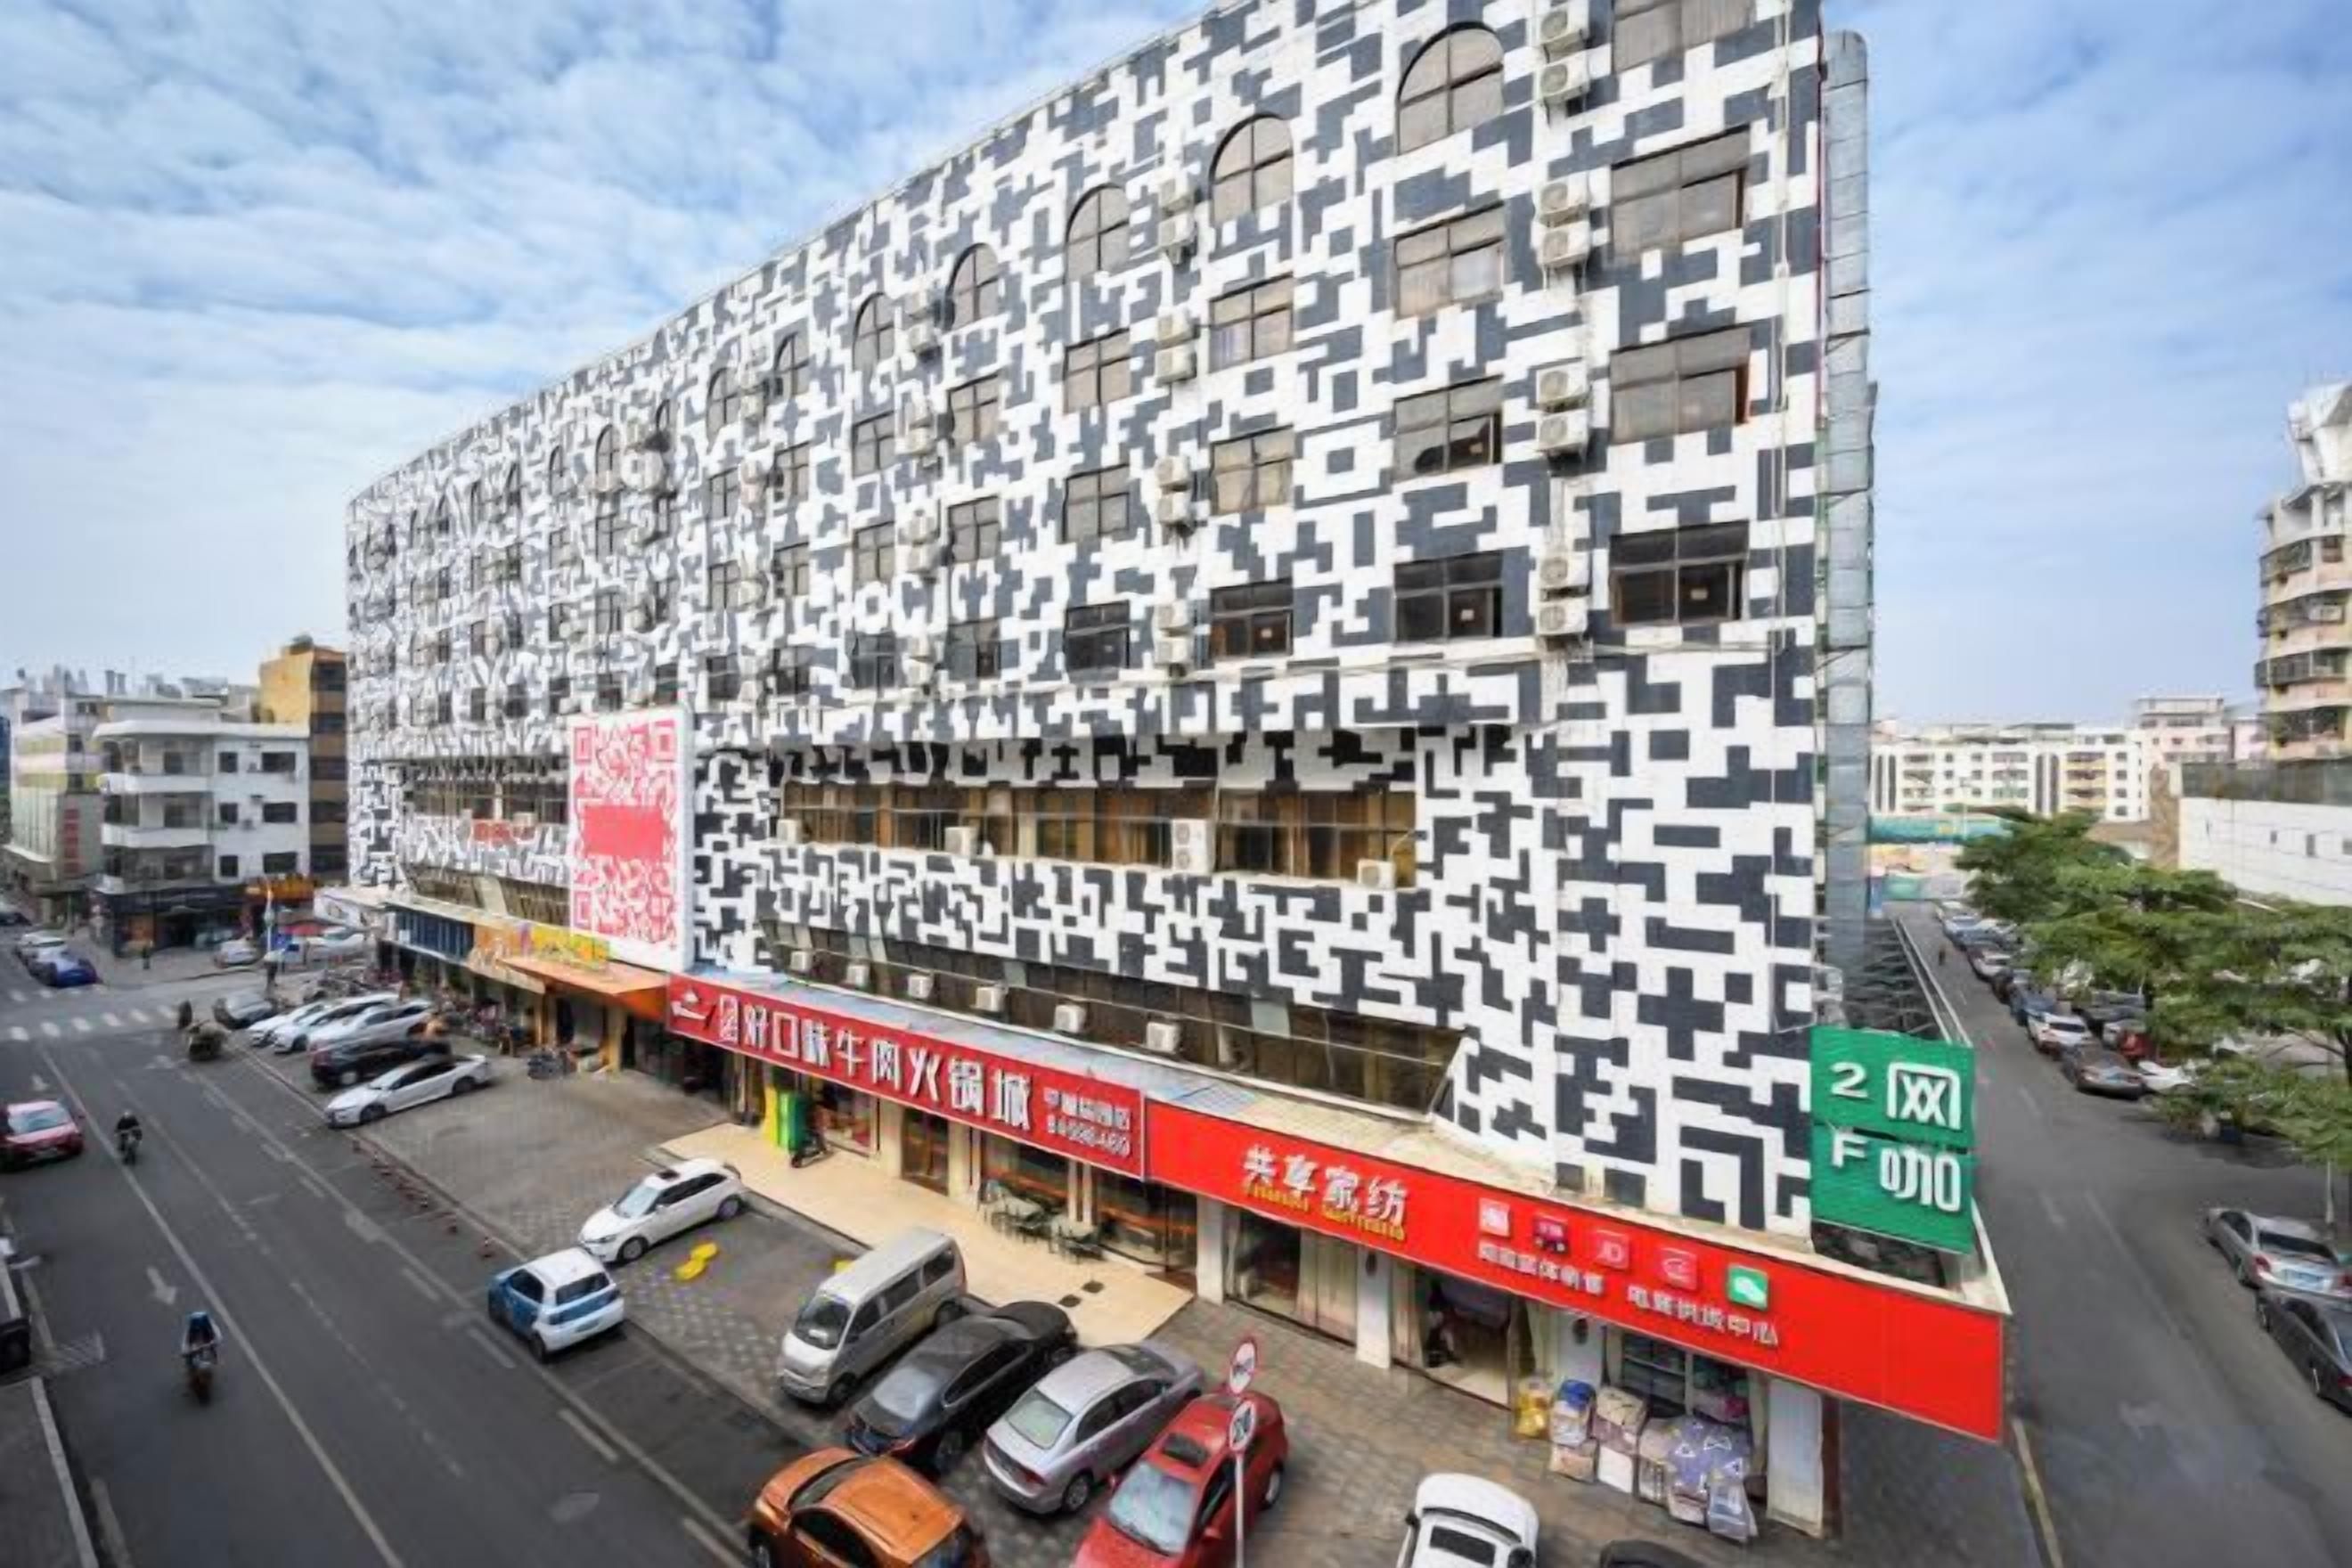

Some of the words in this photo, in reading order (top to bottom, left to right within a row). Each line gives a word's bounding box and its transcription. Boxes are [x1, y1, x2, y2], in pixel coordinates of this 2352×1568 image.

[1241, 1143, 1409, 1229] 共享家纺
[1880, 1060, 1962, 1213] 网咖
